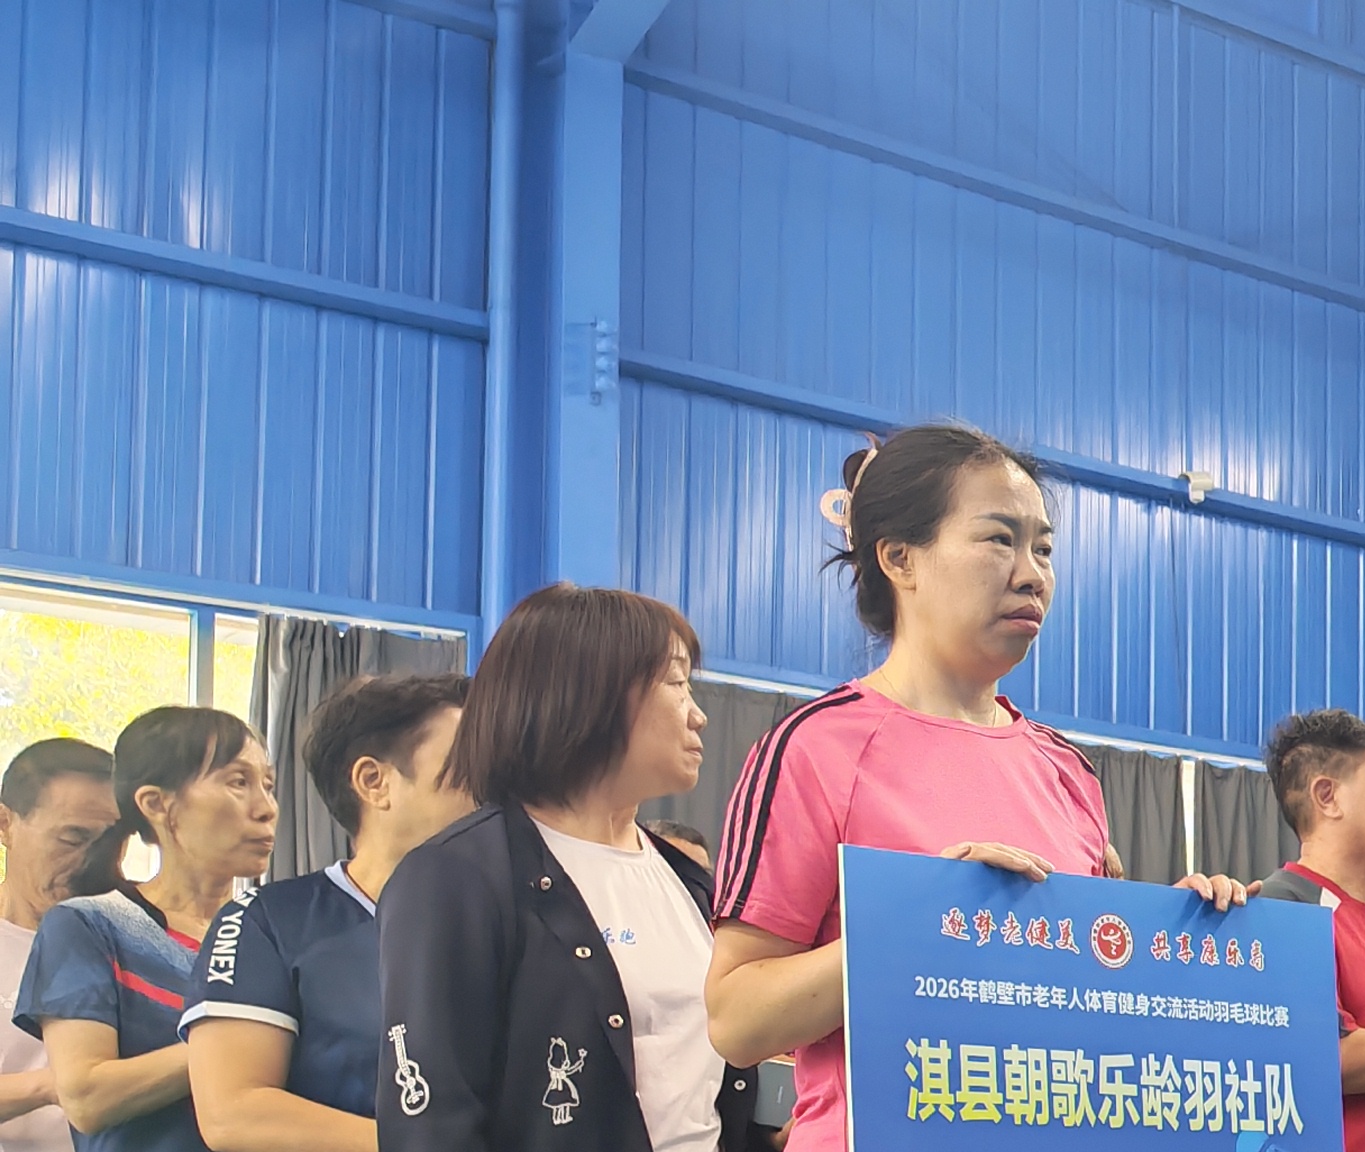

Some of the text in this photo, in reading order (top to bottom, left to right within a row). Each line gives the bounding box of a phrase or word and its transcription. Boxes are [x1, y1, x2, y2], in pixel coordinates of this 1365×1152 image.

[207, 909, 245, 986] YONEX
[914, 975, 1290, 1028] 2026年鹤壁市老年人体育健身交流活动羽毛球比赛
[904, 1037, 1304, 1136] 淇县朝歌乐龄羽社队
